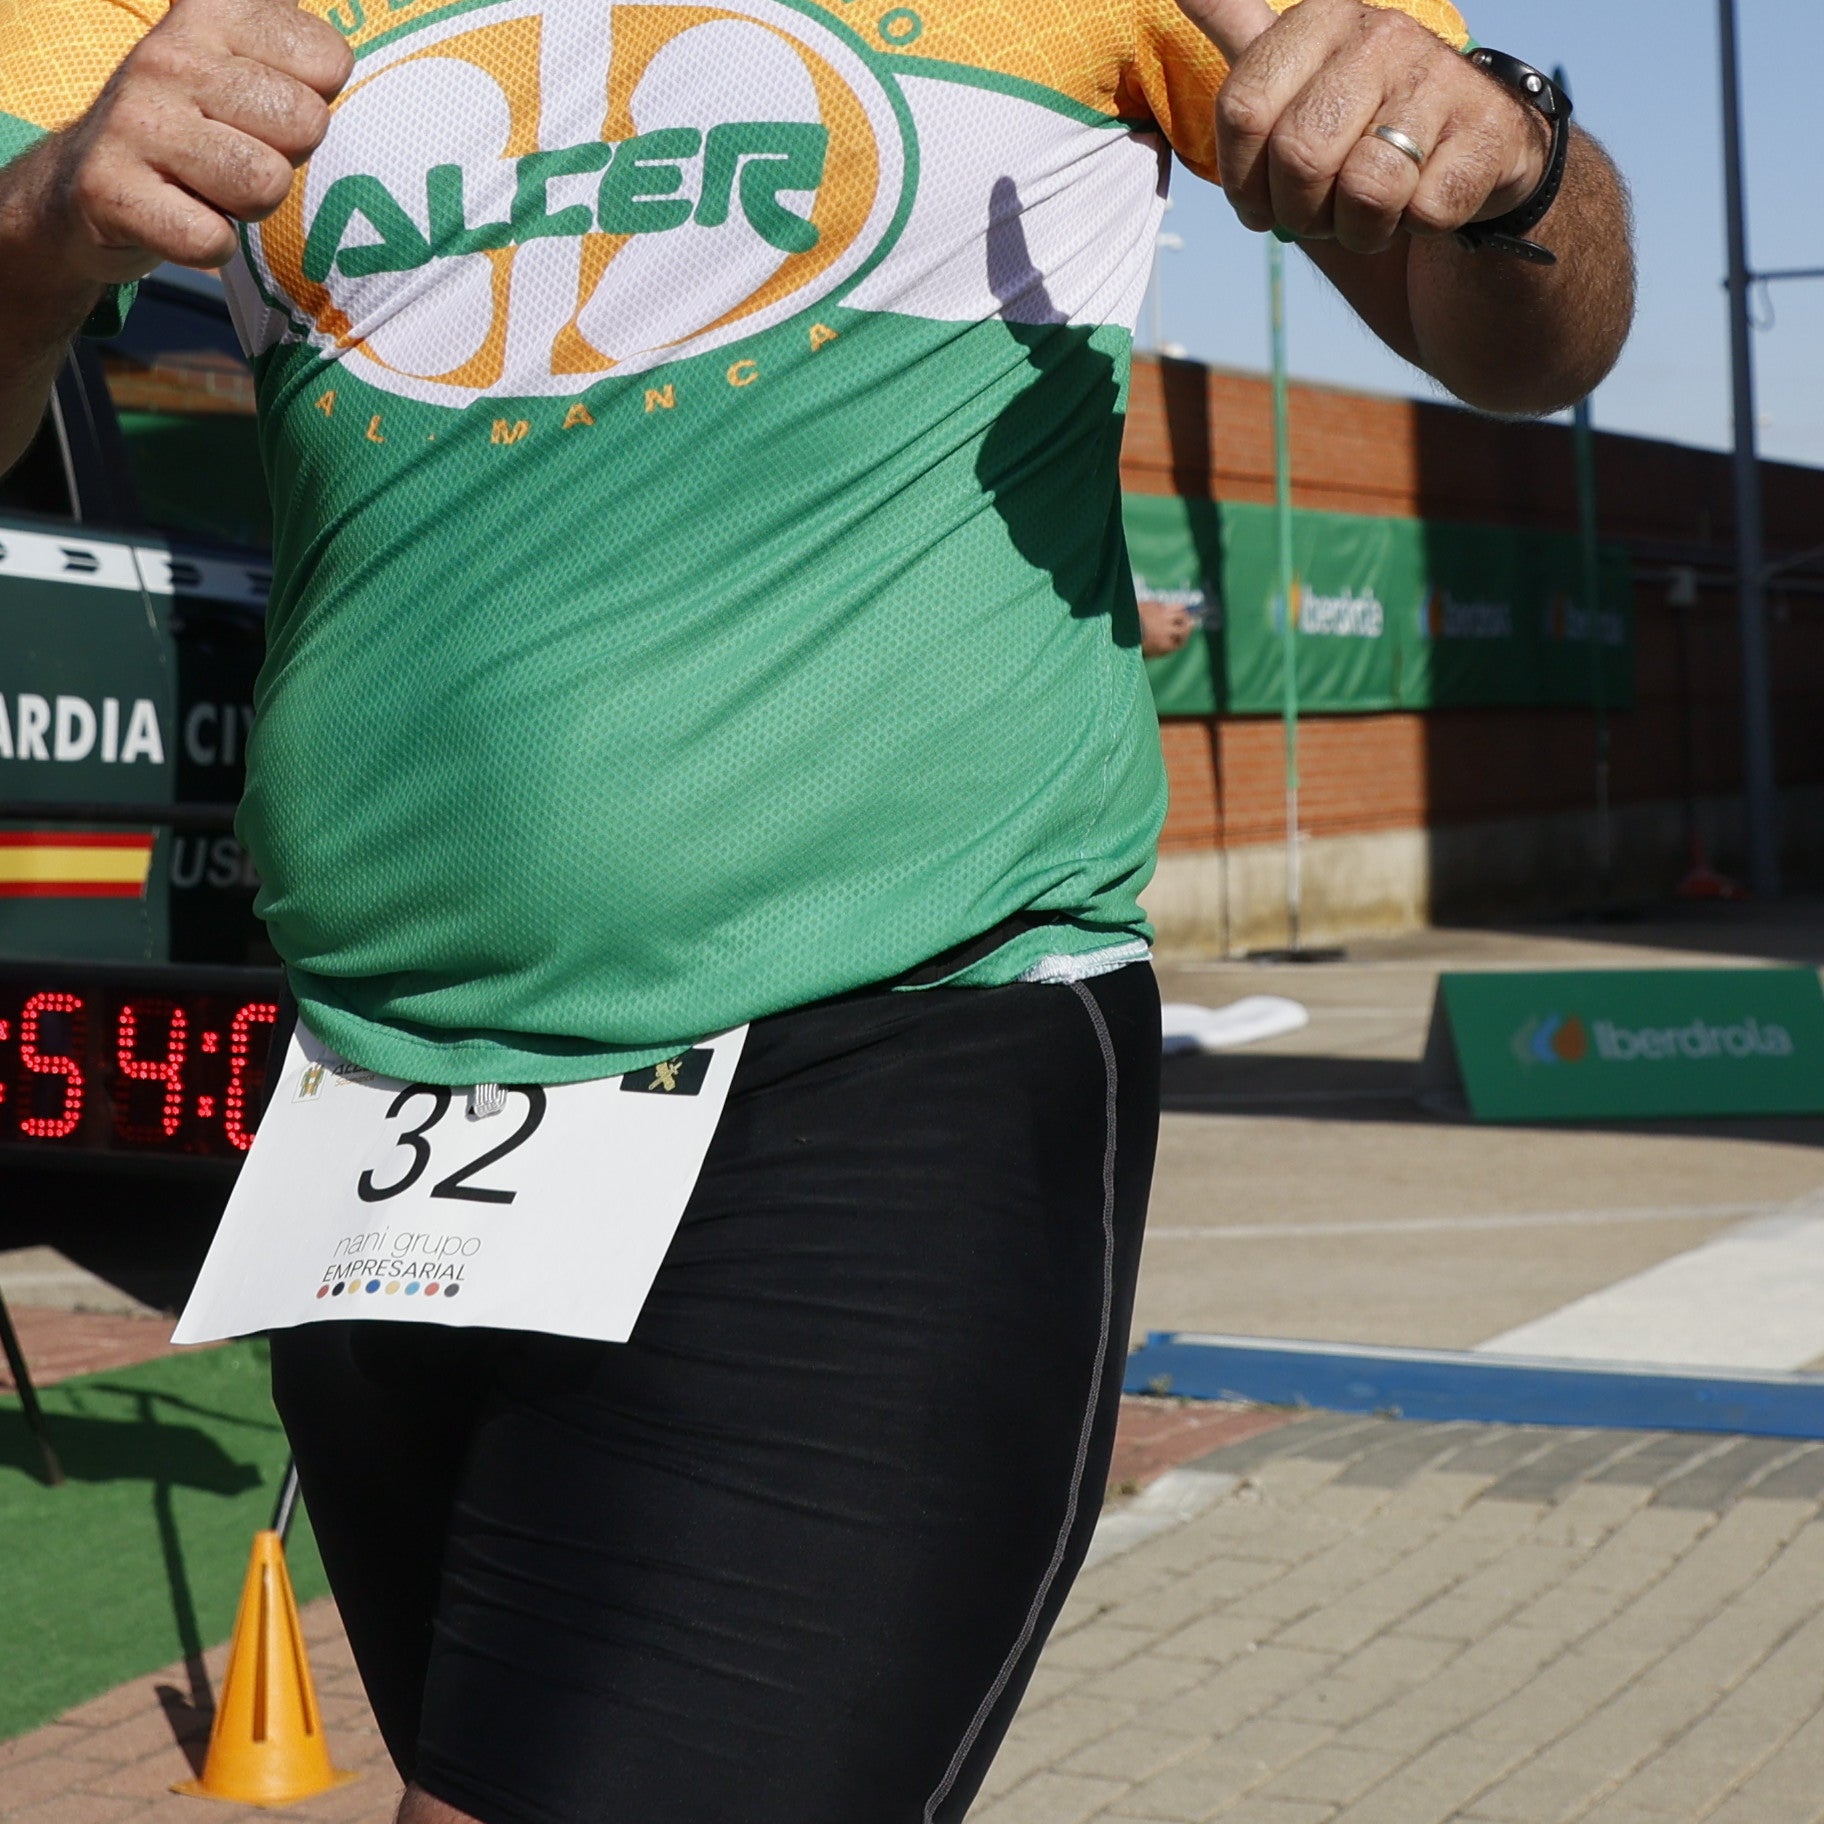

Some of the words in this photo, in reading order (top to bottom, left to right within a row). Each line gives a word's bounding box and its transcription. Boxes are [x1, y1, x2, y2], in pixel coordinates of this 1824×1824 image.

[301, 122, 830, 283] ALCER
[314, 323, 840, 443] ALMANCA
[1593, 1017, 1794, 1060] Iberdrola
[358, 1083, 547, 1204] 32
[323, 1258, 467, 1282] EMPRESARIAL
[333, 1226, 390, 1258] nani
[391, 1228, 481, 1260] grupo
